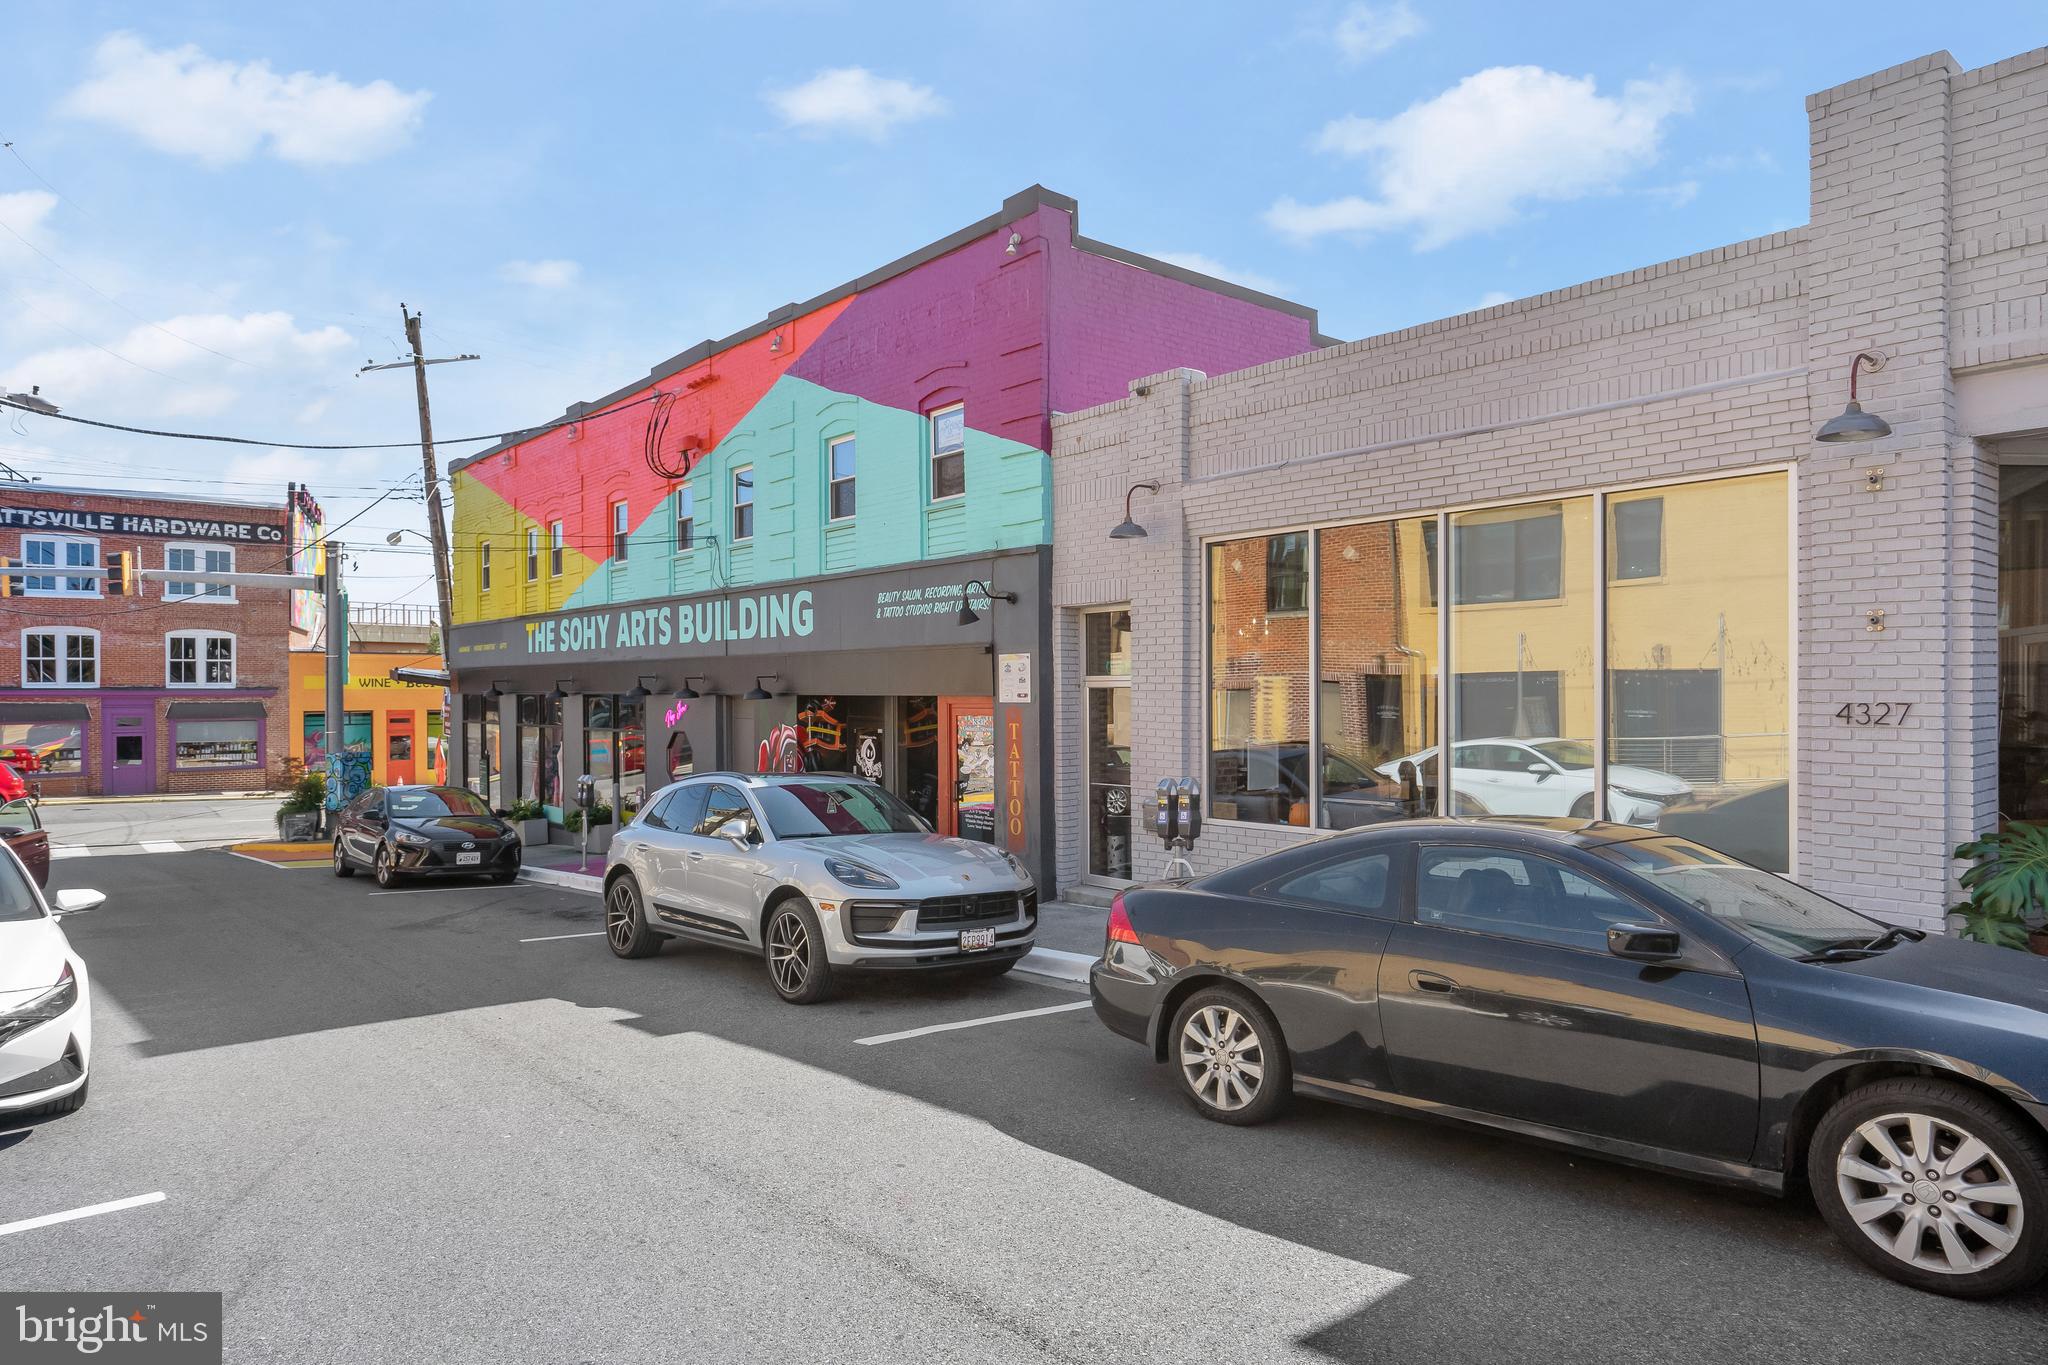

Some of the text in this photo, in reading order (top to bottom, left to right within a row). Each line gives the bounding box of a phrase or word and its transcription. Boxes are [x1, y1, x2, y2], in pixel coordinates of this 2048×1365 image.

[0, 508, 282, 541] TTSVILLE HARDWARE Co
[877, 591, 901, 604] BEAUTY
[525, 590, 814, 653] THE SOHY ARTS BUILDING
[876, 607, 881, 619] &
[883, 606, 904, 618] TATTOO
[905, 603, 932, 616] STUDIOS
[933, 601, 955, 614] RIGHT
[359, 678, 391, 688] WINE
[1835, 702, 1913, 726] 4327
[1008, 722, 1022, 836] TATTOO
